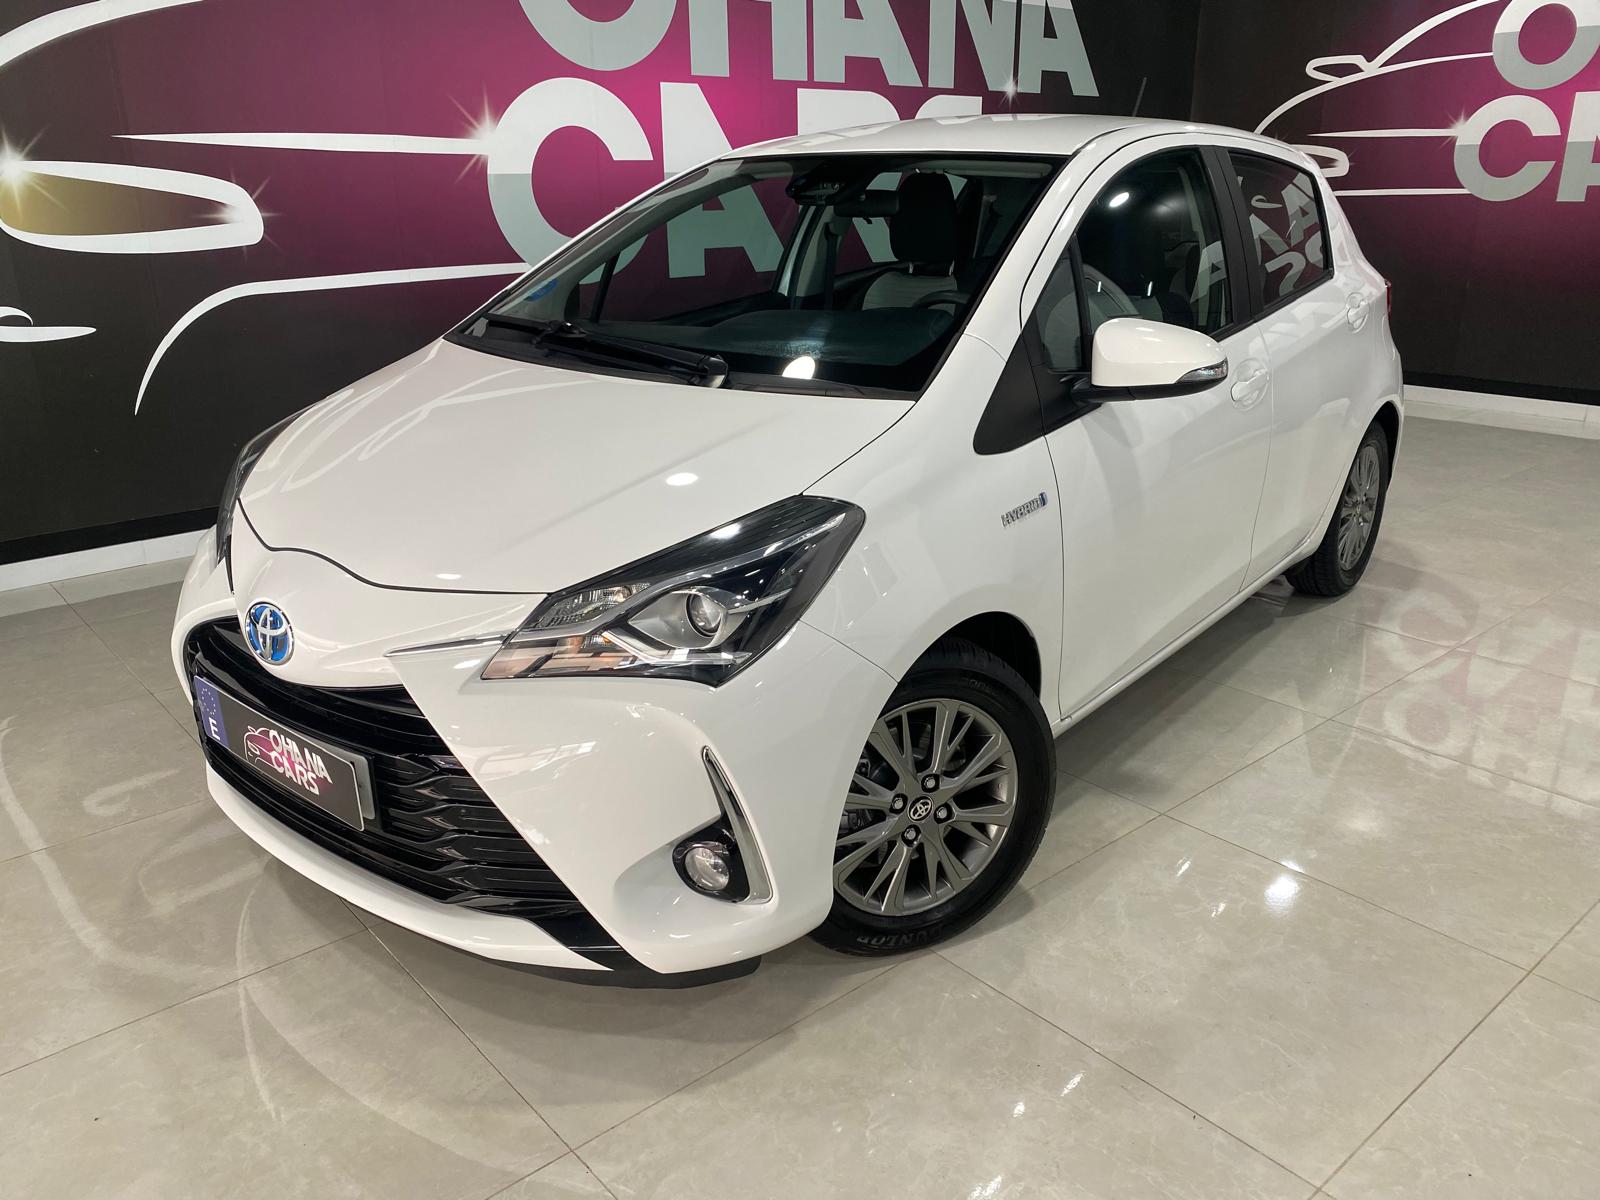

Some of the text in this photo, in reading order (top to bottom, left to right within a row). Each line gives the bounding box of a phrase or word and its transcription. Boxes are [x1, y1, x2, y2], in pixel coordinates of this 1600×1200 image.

[209, 717, 221, 741] E
[269, 730, 333, 784] OHANA
[269, 751, 320, 795] CARS
